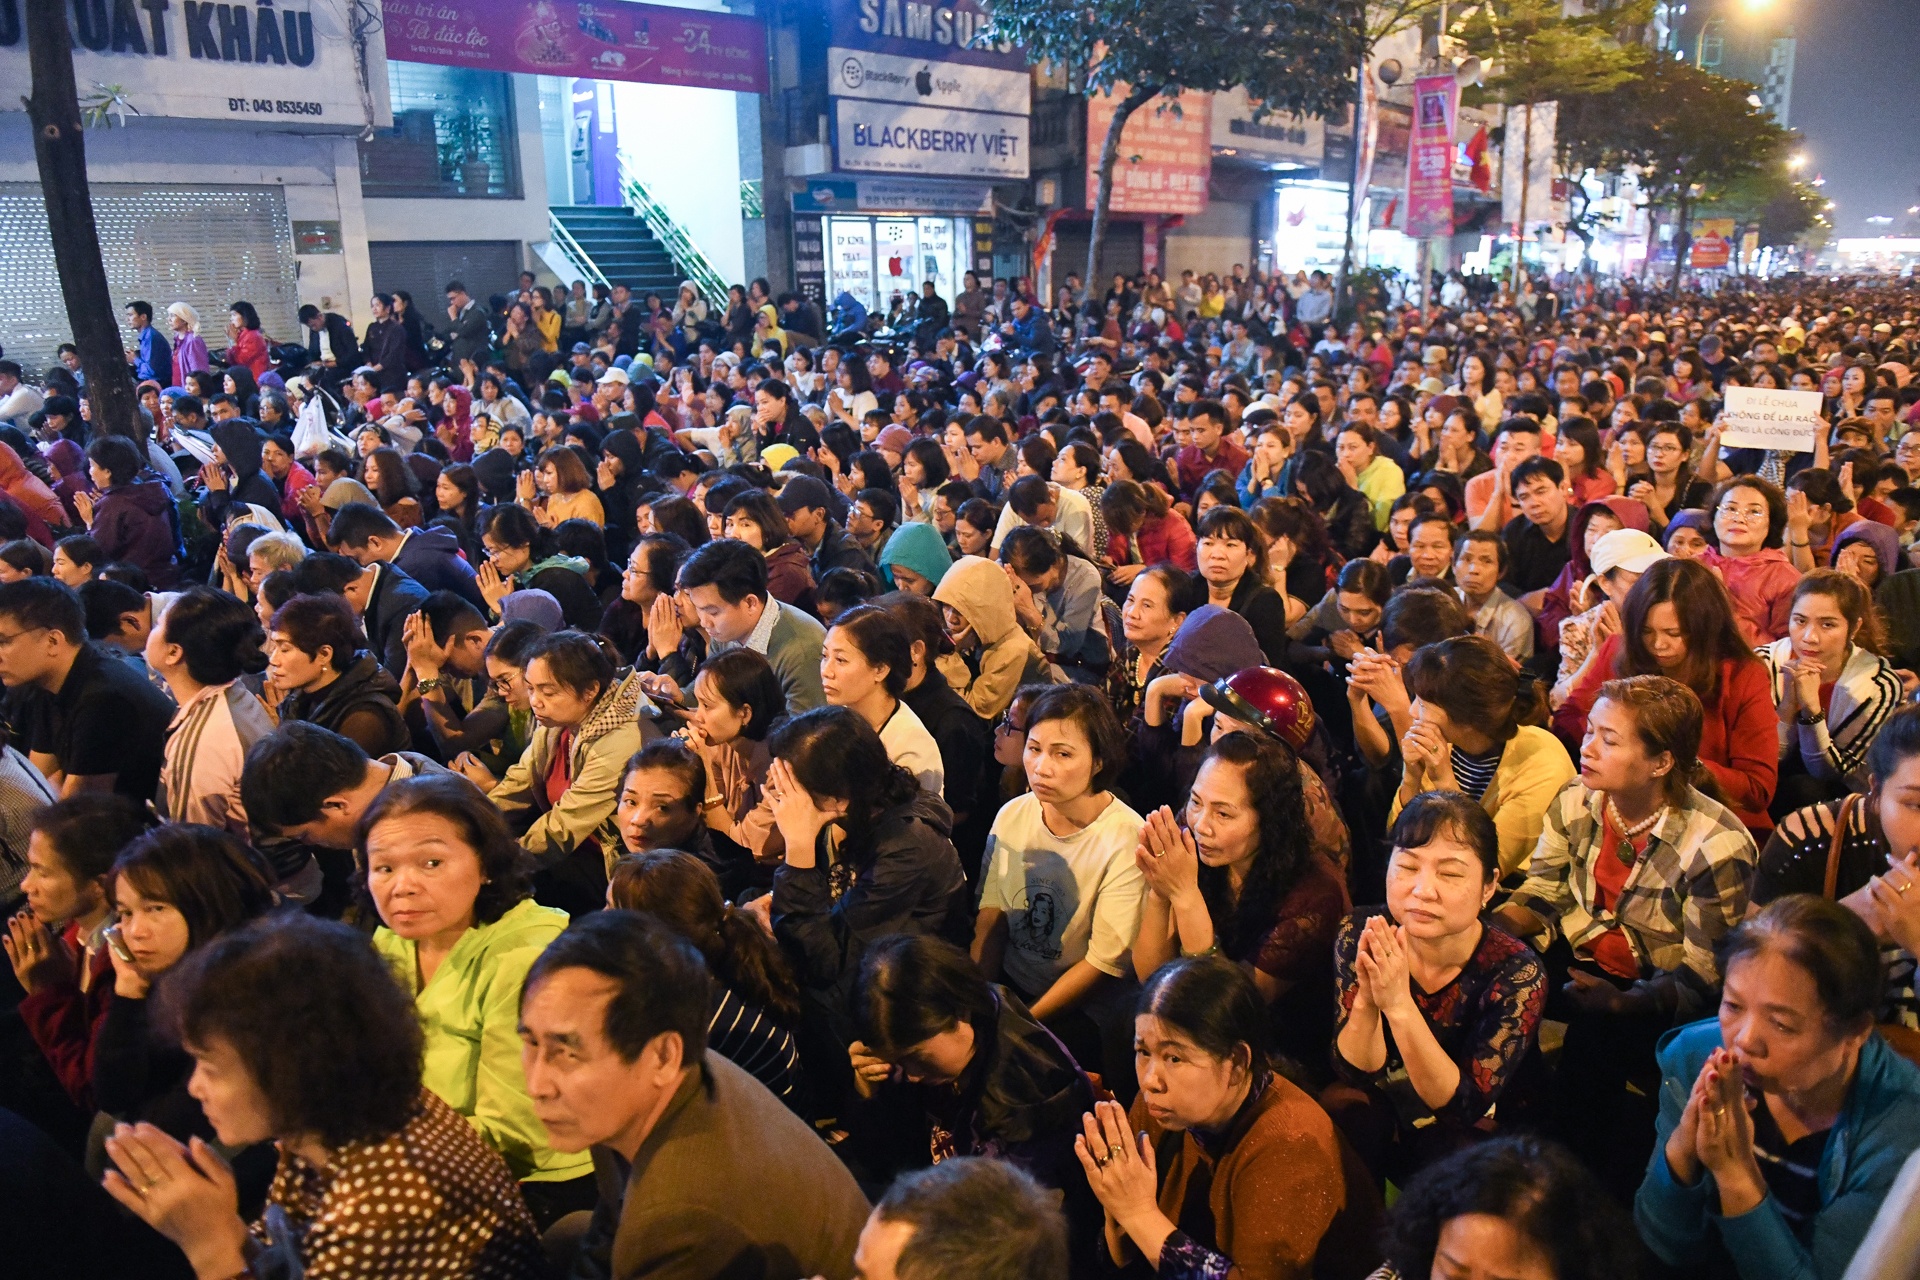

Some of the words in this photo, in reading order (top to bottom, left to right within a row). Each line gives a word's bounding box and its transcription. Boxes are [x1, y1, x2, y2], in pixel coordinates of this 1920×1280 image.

[935, 78, 961, 95] Apple
[228, 97, 250, 112] ĐT:
[253, 99, 273, 113] 043
[276, 100, 323, 116] 8535450
[853, 123, 977, 154] BLACKBERRY
[982, 128, 1018, 162] VIỆT
